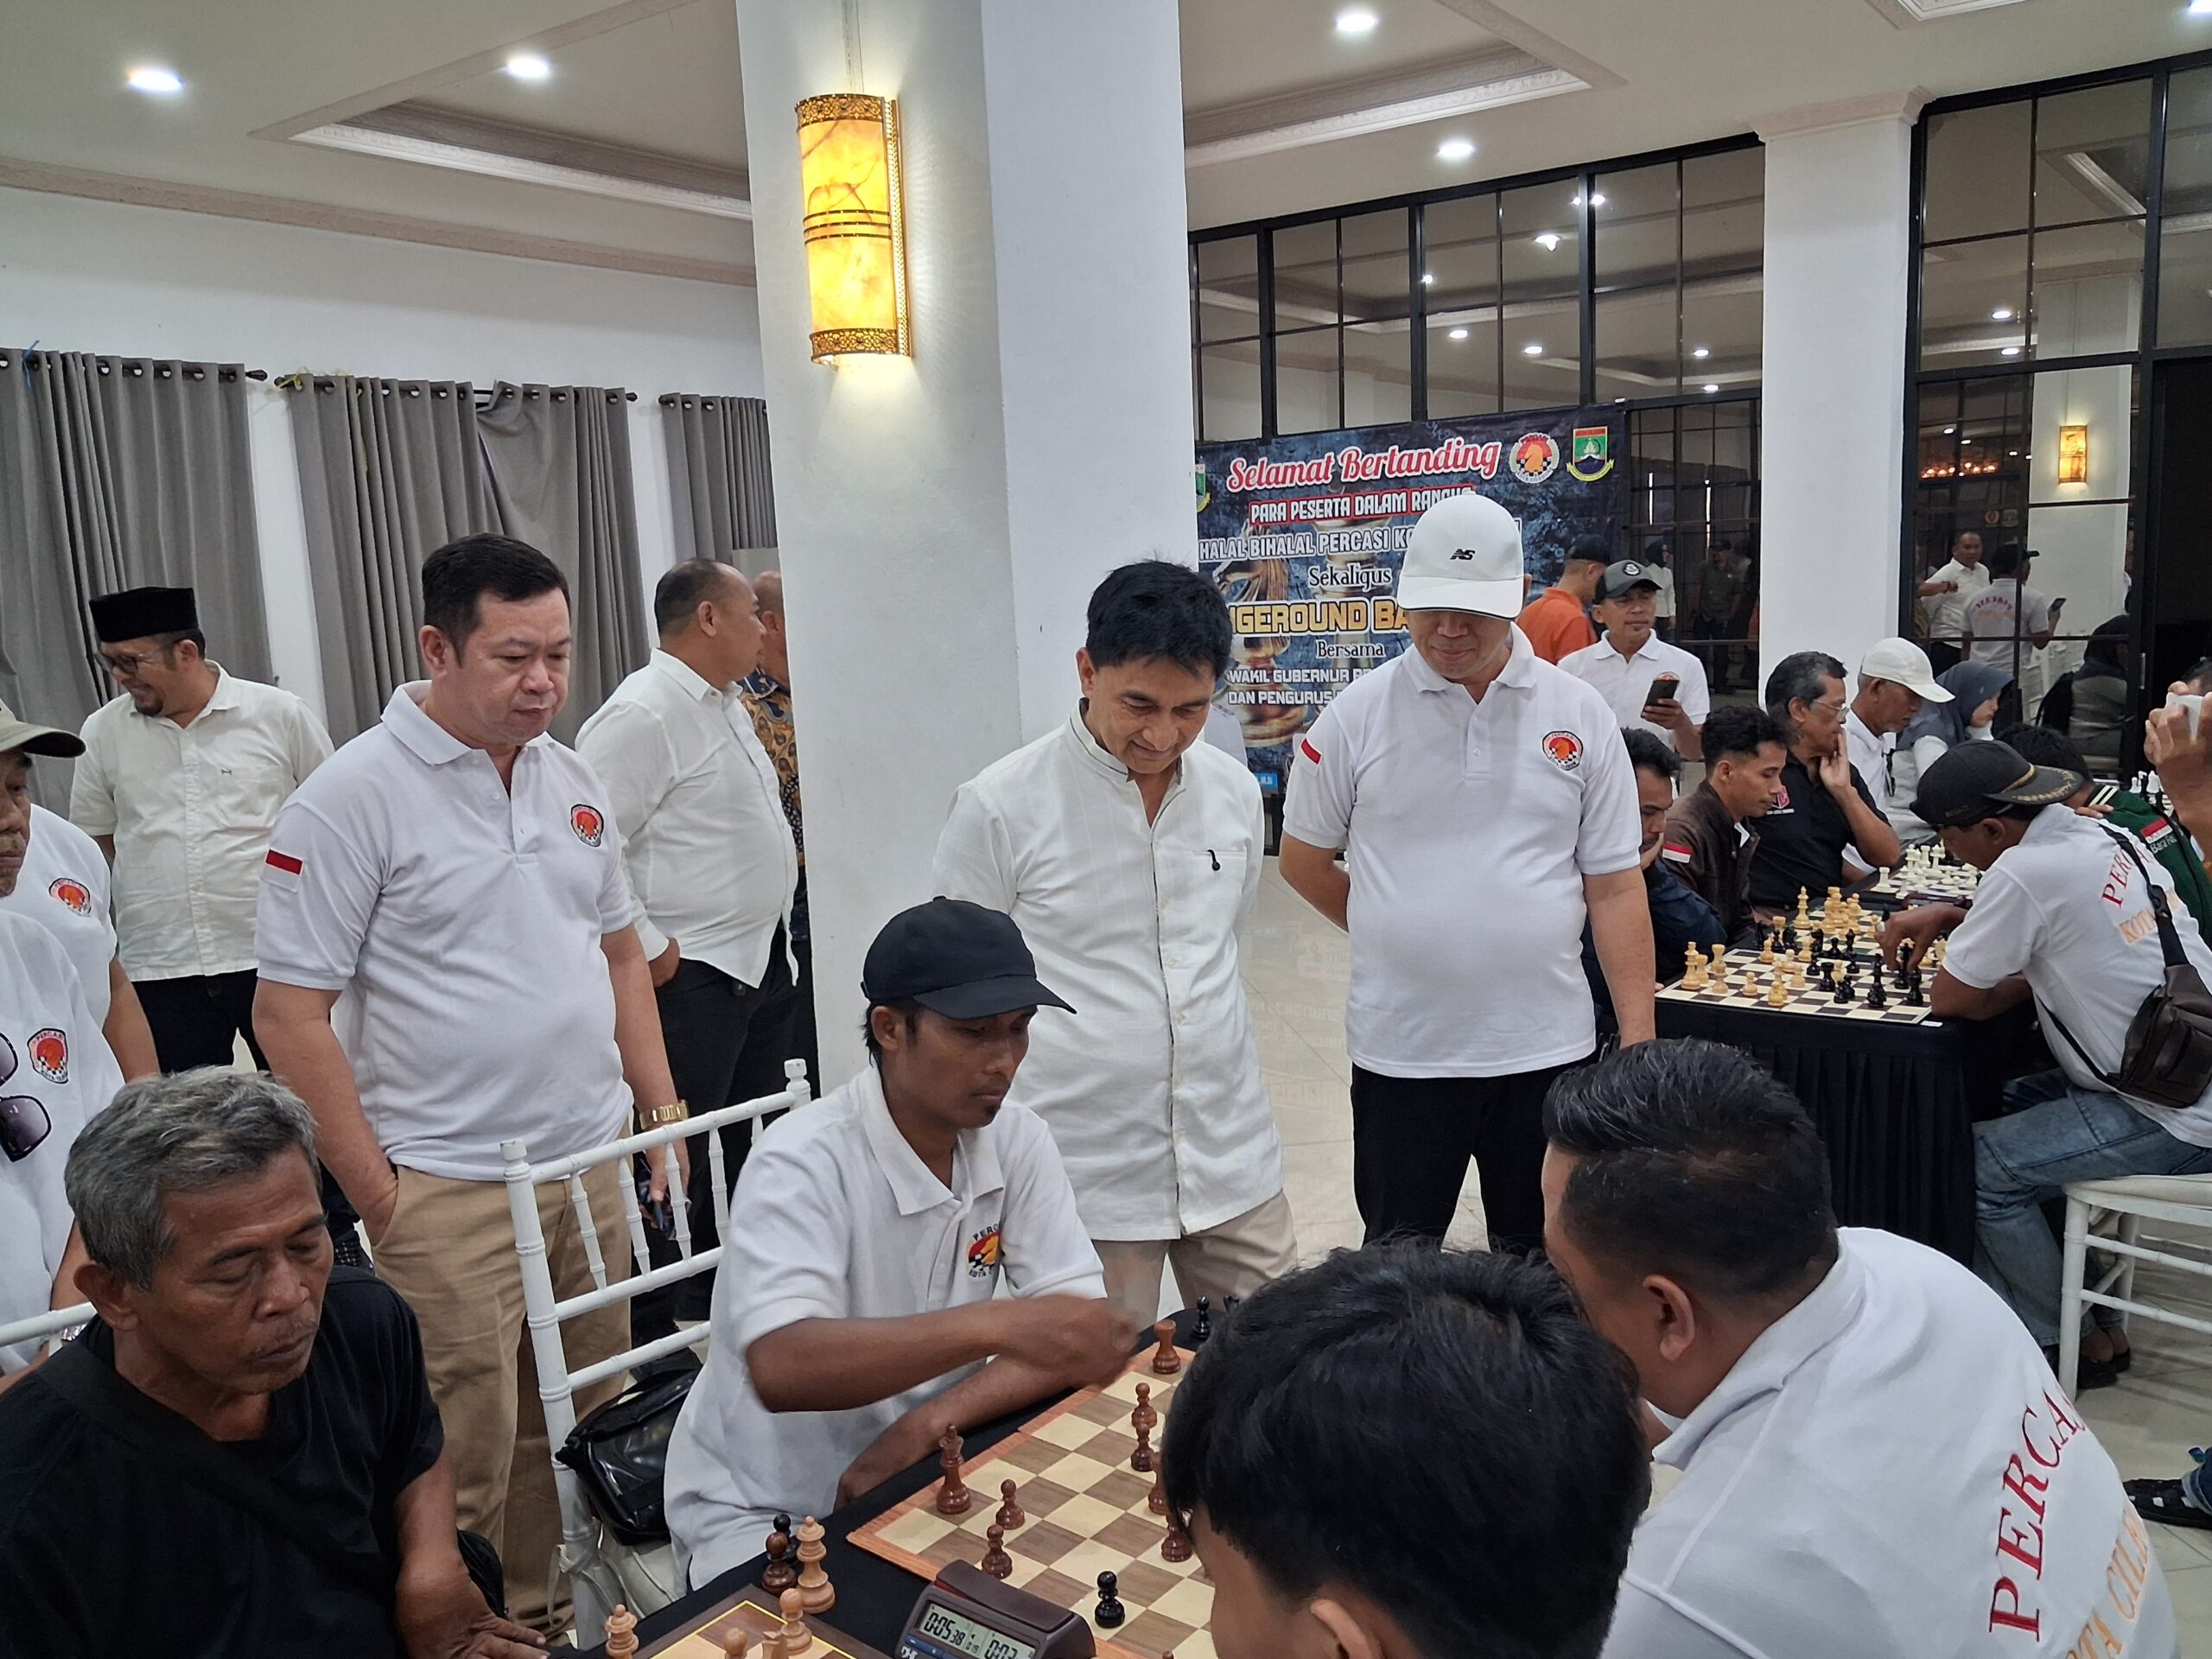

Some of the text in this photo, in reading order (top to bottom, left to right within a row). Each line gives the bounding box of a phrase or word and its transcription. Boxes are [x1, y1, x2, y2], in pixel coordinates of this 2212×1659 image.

[1227, 437, 1502, 492] Selamat Bertanding
[1251, 502, 1287, 523] PARA
[1291, 497, 1351, 520] PESERTA
[1355, 492, 1408, 516] DALAM
[1199, 540, 1246, 560] HALAL
[1251, 534, 1314, 557] BIHALAL
[1319, 529, 1389, 554] PERCASI
[1309, 564, 1392, 592] Sekaligus
[1317, 640, 1384, 658] Bersama
[1229, 669, 1271, 683] WAKIL
[1273, 668, 1350, 683] GUBERNUR
[1228, 690, 1255, 704] DAN
[1258, 690, 1333, 704] PENGURUS
